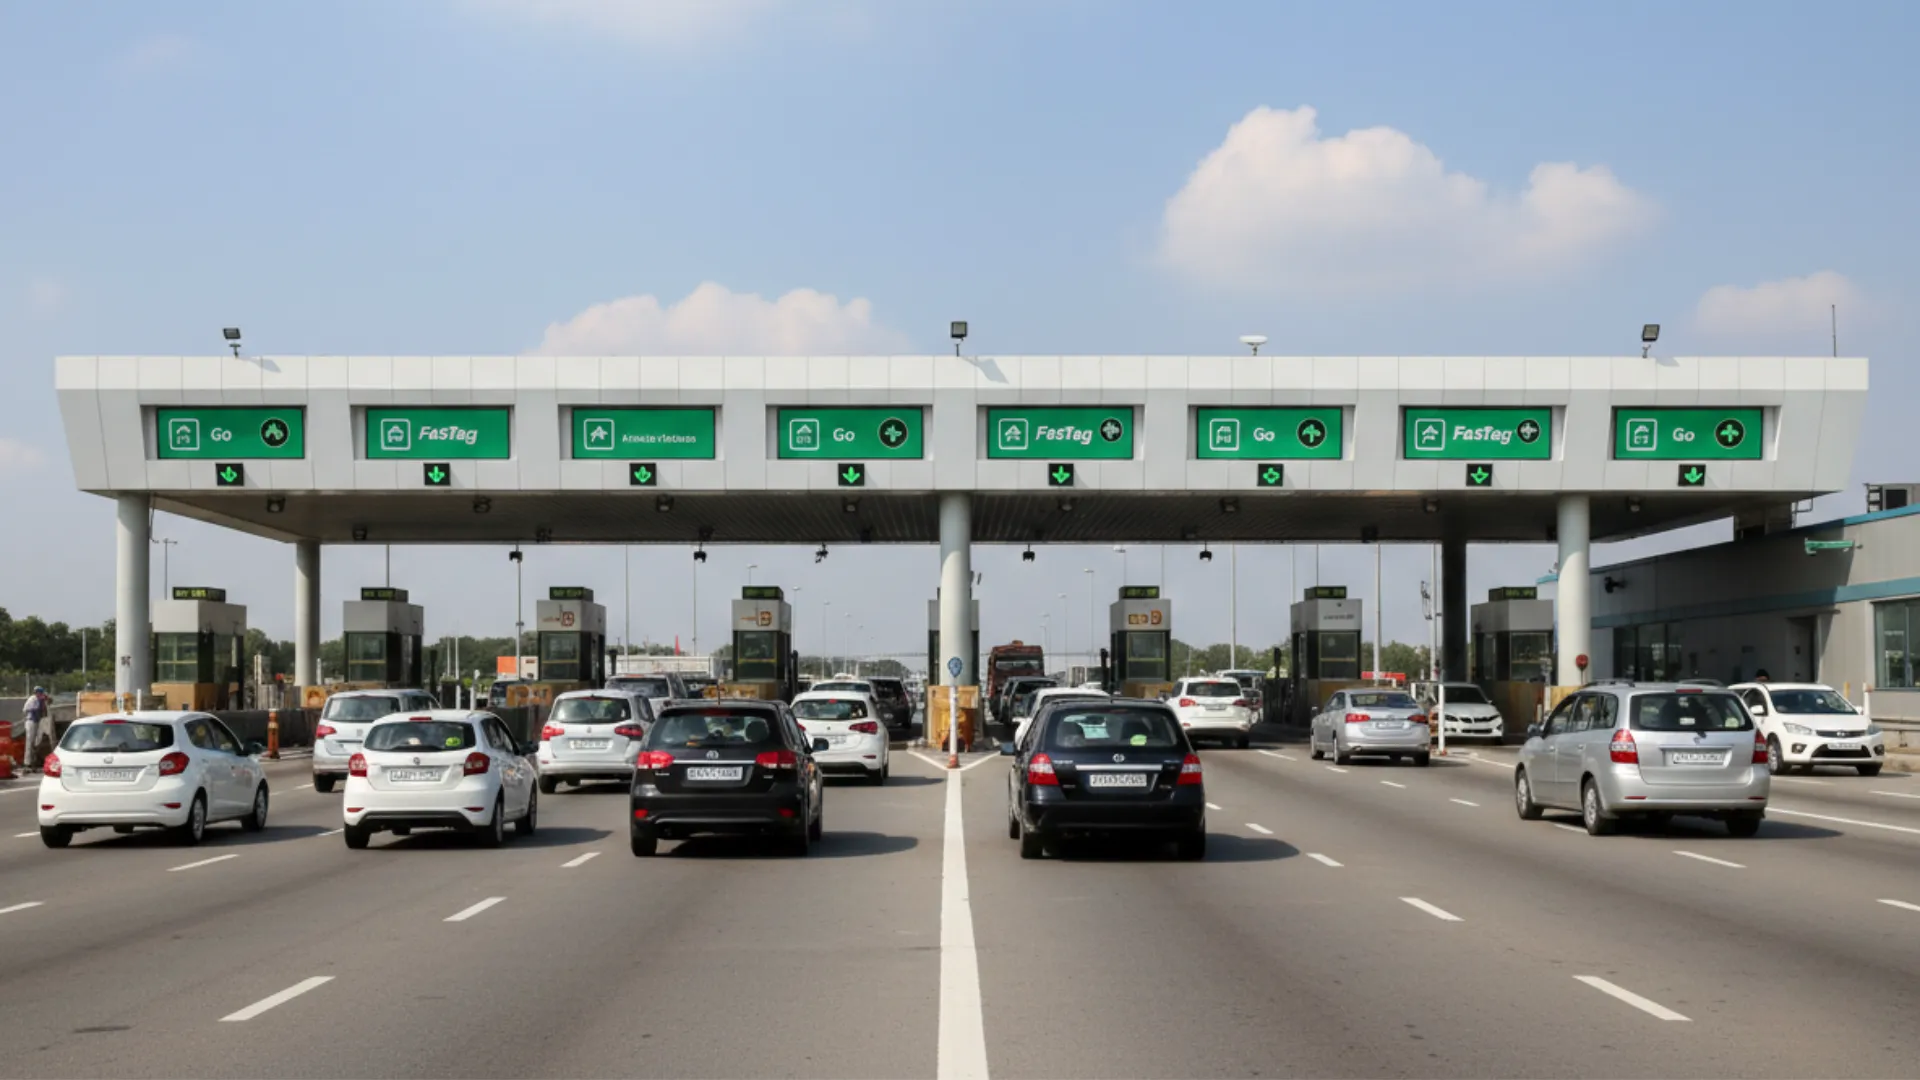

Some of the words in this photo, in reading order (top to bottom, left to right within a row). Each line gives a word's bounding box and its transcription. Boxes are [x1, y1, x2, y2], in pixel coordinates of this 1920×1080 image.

[210, 427, 232, 442] Go
[832, 427, 856, 442] Go
[1253, 427, 1276, 442] Go
[1672, 427, 1696, 442] Go
